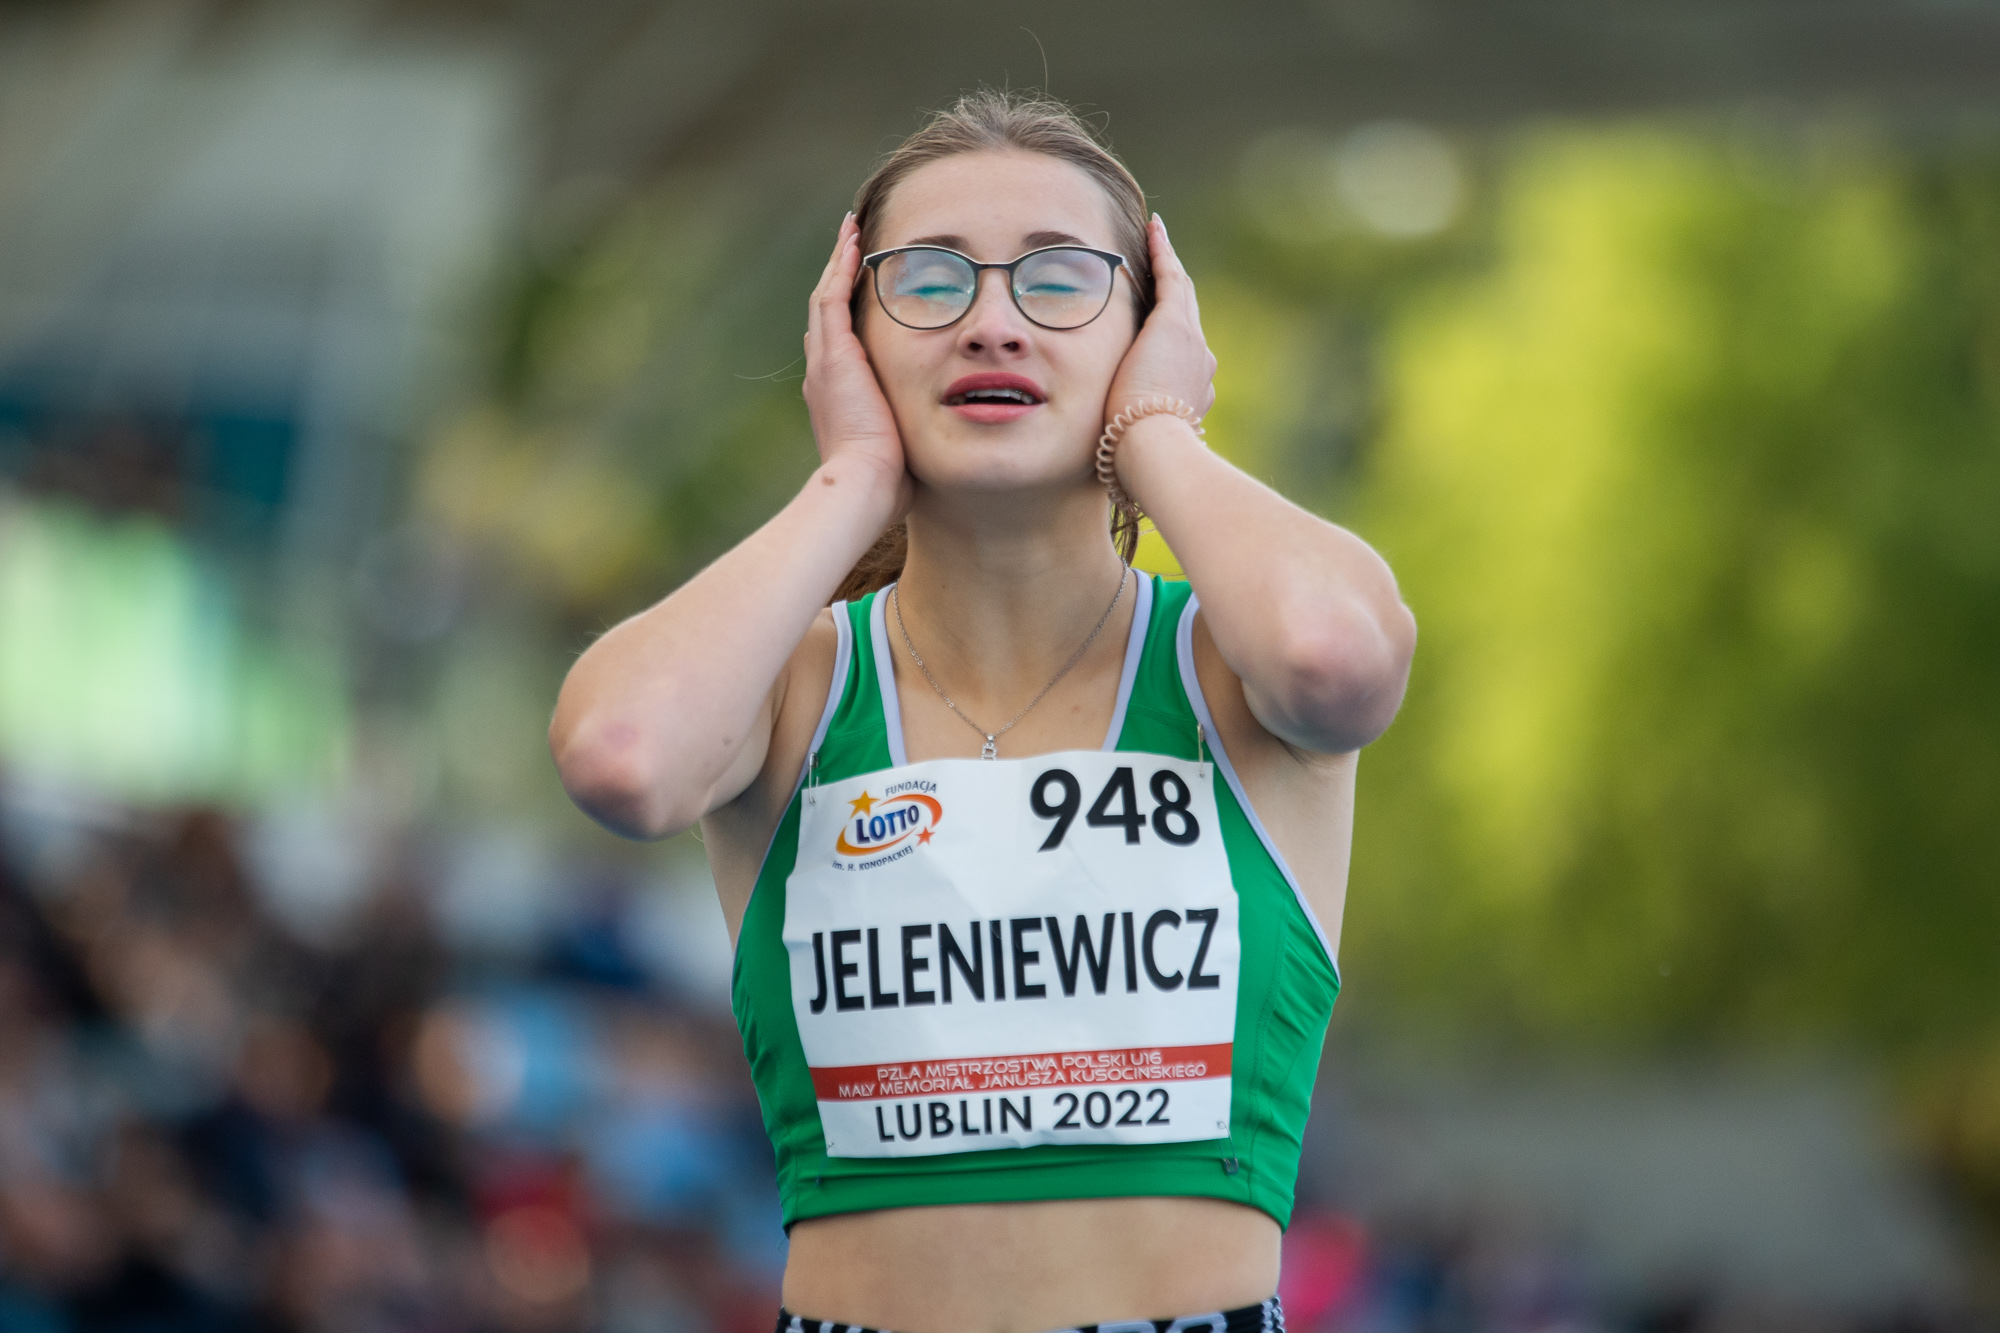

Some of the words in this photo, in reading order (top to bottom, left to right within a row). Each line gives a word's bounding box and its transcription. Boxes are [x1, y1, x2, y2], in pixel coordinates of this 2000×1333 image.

[885, 780, 937, 797] FUNDACJA
[855, 804, 920, 845] LOTTO
[1030, 767, 1201, 853] 948
[831, 860, 845, 871] im.
[847, 864, 857, 872] H.
[858, 845, 913, 872] KONOPACKIEJ
[809, 907, 1221, 1015] JELENIEWICZ
[838, 1083, 875, 1098] MAŁY
[879, 1077, 974, 1096] MEMORIAŁ
[978, 1071, 1067, 1089] JANUSZA
[877, 1067, 921, 1082] PZLA
[925, 1058, 1058, 1078] MISTRZOSTWA
[1062, 1053, 1126, 1069] POLSKI
[1130, 1051, 1162, 1066] U16
[875, 1096, 1032, 1143] LUBLIN
[1052, 1088, 1170, 1131] 2022
